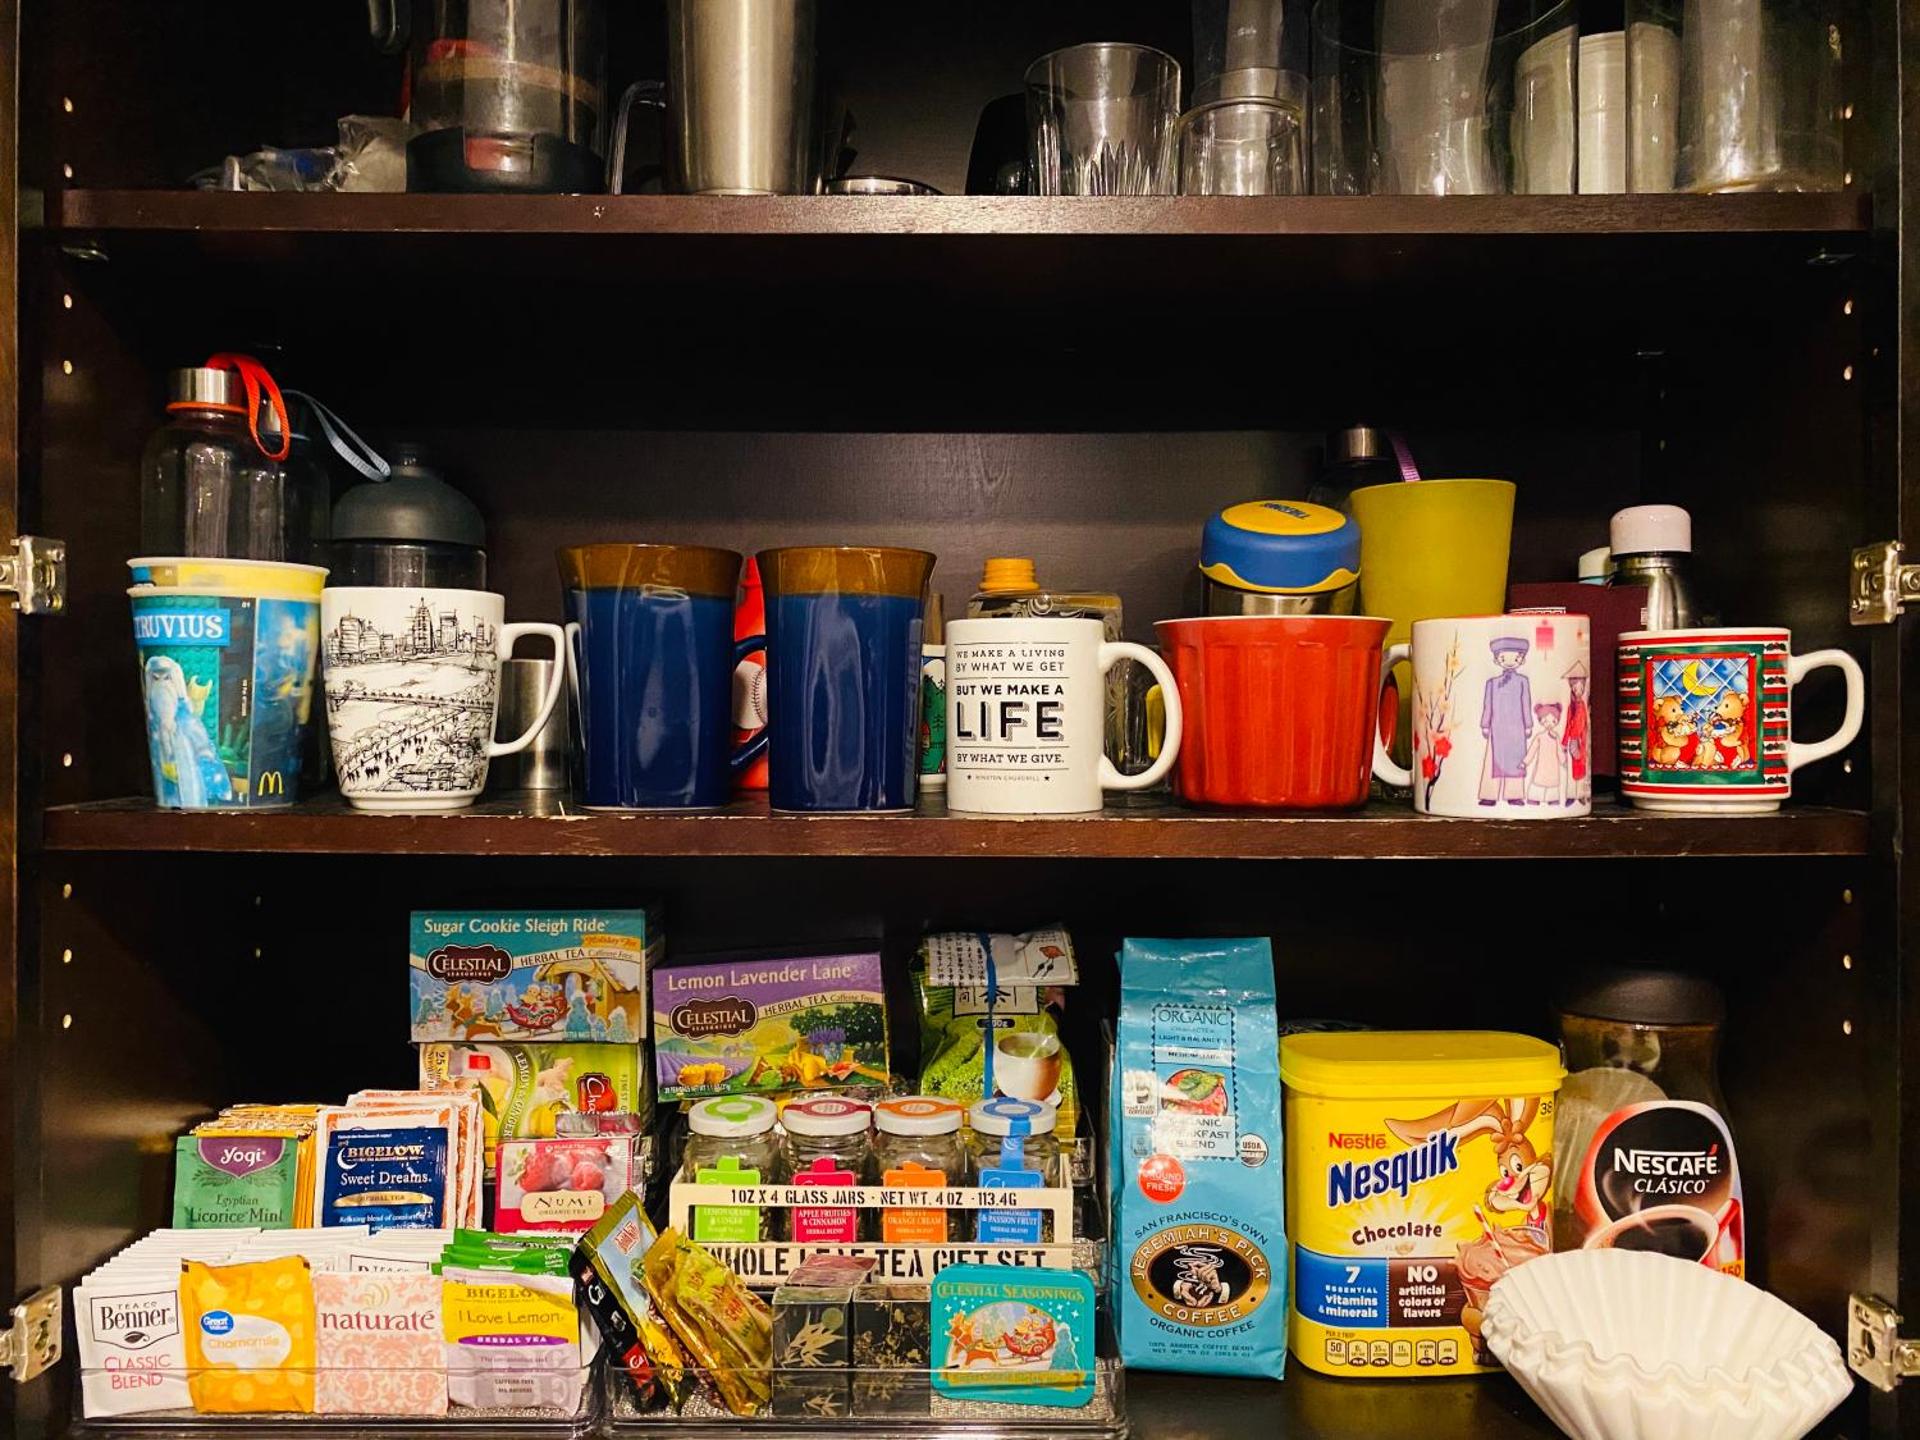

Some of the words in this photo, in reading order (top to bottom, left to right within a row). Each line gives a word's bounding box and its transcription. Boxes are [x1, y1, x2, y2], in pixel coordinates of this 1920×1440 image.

[956, 650, 969, 659] WE
[972, 649, 1003, 658] MAKE
[1008, 649, 1016, 657] A
[1022, 649, 1065, 658] LIVING
[956, 663, 967, 672] BY
[971, 662, 1007, 672] WHAT
[1013, 661, 1033, 672] WE
[1040, 661, 1065, 672] GET
[956, 685, 976, 695] BUT
[980, 684, 1002, 695] WE
[1007, 684, 1050, 695] MAKE
[1054, 684, 1064, 695] A
[957, 701, 1064, 741] LIFE
[957, 754, 968, 763] BY
[970, 754, 1004, 763] WHAT
[1007, 754, 1028, 763] WE
[1031, 754, 1065, 763] GIVE.
[424, 918, 465, 937] Sugar
[469, 918, 521, 933] Cookie
[525, 918, 568, 937] Sleigh
[573, 918, 606, 932] Ride
[433, 954, 506, 974] CELESTIAL
[520, 952, 560, 966] HERBAL
[566, 949, 585, 959] TEA
[668, 974, 725, 991] Lemon
[730, 965, 807, 987] Lavender
[812, 963, 853, 980] Lane
[764, 1000, 803, 1016] HERBAL
[808, 994, 828, 1006] TEA
[677, 1010, 750, 1029] CELESTIAL
[1158, 1009, 1229, 1026] ORGANIC
[436, 1051, 446, 1065] 25
[515, 1052, 530, 1088] LEMON
[620, 1073, 629, 1100] FINEST
[503, 1100, 524, 1140] GINGER
[347, 1144, 424, 1158] BIGELOW
[1242, 1140, 1262, 1150] USDA
[1614, 1143, 1718, 1176] NESCAFÉ
[1328, 1130, 1459, 1208] Nesquik
[340, 1172, 375, 1186] Sweet
[1634, 1177, 1706, 1194] CLÁSICO
[1146, 1182, 1178, 1193] FRESH
[216, 1194, 259, 1207] Egyptian
[758, 1190, 767, 1204] X
[770, 1190, 778, 1204] 4
[785, 1190, 828, 1205] GLASS
[831, 1190, 865, 1206] JARS
[881, 1191, 905, 1206] NET
[978, 1192, 1017, 1207] 113.4G
[189, 1207, 246, 1223] Licorice
[367, 1214, 384, 1222] blend
[798, 1209, 819, 1217] APPLE
[888, 1217, 915, 1225] ORANGE
[917, 1217, 942, 1225] CREAM
[988, 1216, 1016, 1224] PASSION
[1016, 1217, 1038, 1225] FRUIT
[808, 1218, 847, 1226] CINNAMON
[1134, 1219, 1159, 1239] SAN
[1159, 1211, 1239, 1227] FRANCISCO'S
[1241, 1222, 1269, 1246] OWN
[1352, 1222, 1443, 1246] Chocolate
[1132, 1225, 1230, 1281] JEREMIAH'S
[1236, 1241, 1268, 1280] PICK
[876, 1249, 924, 1277] TEA
[1345, 1265, 1361, 1284] 7
[1407, 1265, 1439, 1283] NO
[936, 1281, 1000, 1299] CELESTIAL
[1002, 1283, 1085, 1304] SEASONINGS
[1325, 1285, 1378, 1294] ESSENTIAL
[1398, 1284, 1446, 1297] artificial
[118, 1302, 139, 1310] TEA
[1325, 1294, 1379, 1306] vitamins
[1398, 1296, 1432, 1307] colors
[1433, 1298, 1446, 1307] or
[101, 1306, 171, 1331] Benner
[467, 1310, 504, 1324] Love
[507, 1311, 561, 1324] Lemon
[1162, 1303, 1242, 1325] COFFEE
[1325, 1305, 1379, 1318] minerals
[1403, 1307, 1441, 1318] flavors
[203, 1315, 228, 1327] Great
[1150, 1317, 1205, 1339] ORGANIC
[1207, 1320, 1256, 1339] COFFEE
[209, 1335, 281, 1349] Chamomile
[477, 1336, 521, 1344] HERBAL
[1330, 1341, 1341, 1353] 50
[104, 1353, 171, 1372] CLASSIC
[111, 1373, 164, 1390] BLEND
